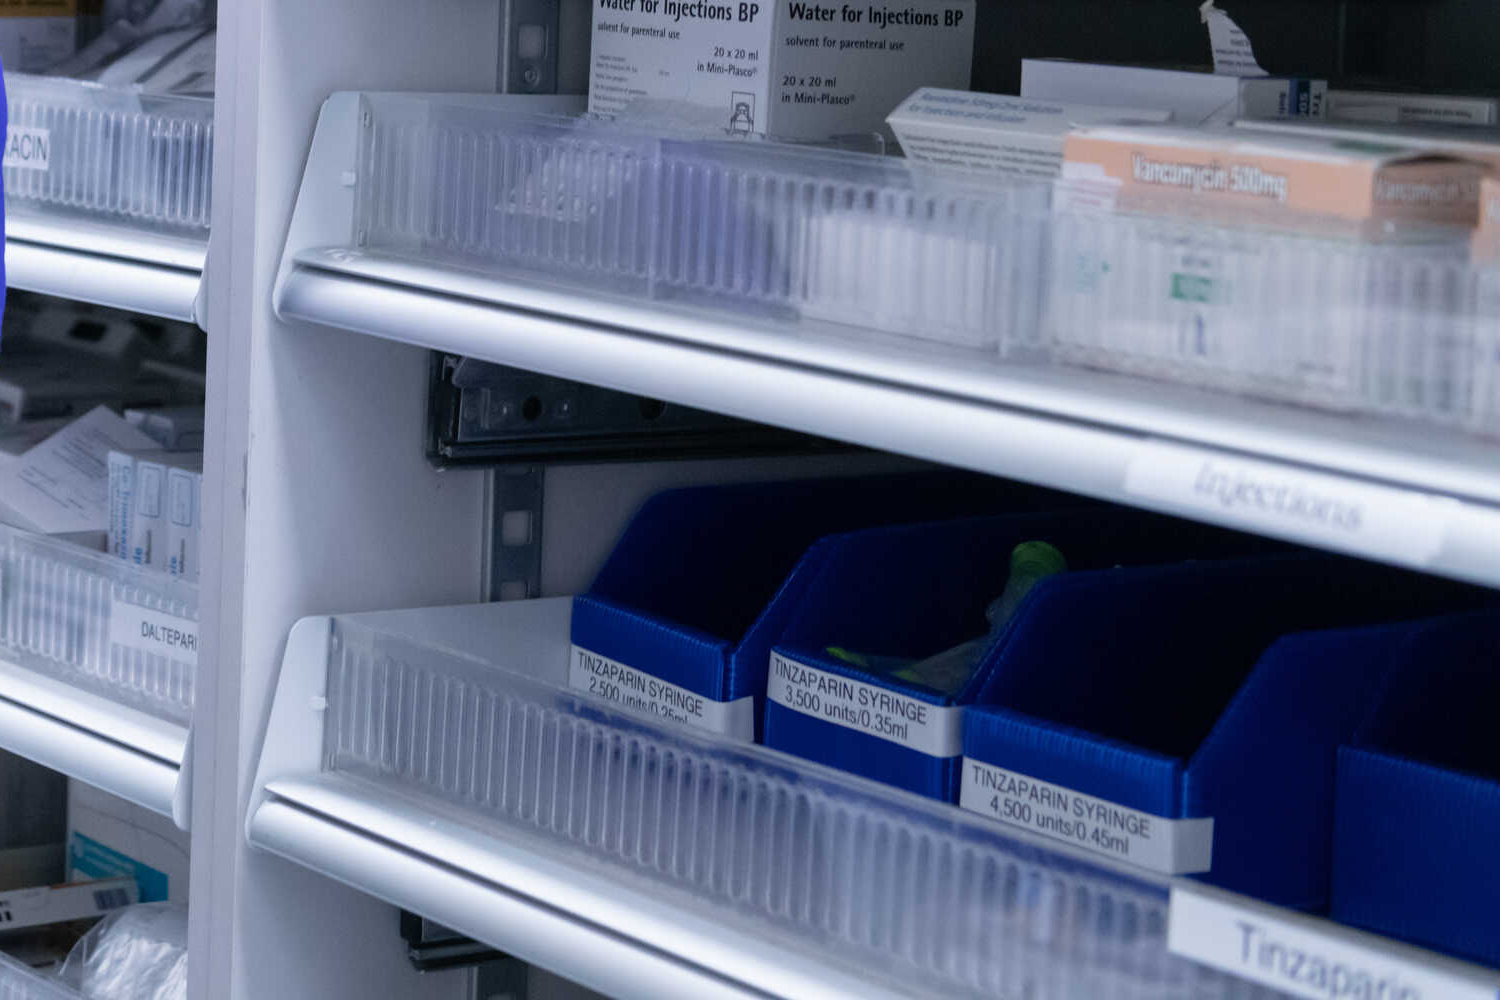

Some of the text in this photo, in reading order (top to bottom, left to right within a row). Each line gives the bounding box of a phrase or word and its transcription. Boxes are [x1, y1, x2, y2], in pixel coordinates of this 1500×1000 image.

[738, 2, 760, 23] BP
[789, 2, 965, 30] Water for Injections BP
[597, 21, 681, 41] solvent for parenteral use
[786, 35, 905, 51] solvent for parenteral use
[714, 46, 759, 61] 20 x 20 ml
[697, 61, 705, 73] in
[782, 76, 838, 89] 20 x 20 ml
[781, 91, 792, 104] in
[1132, 151, 1229, 194] Vancomycin
[578, 651, 704, 718] TINZAPARIN SYRINGE
[774, 657, 928, 726] TINZAPARIN SYRINGE
[785, 684, 909, 741] 3,500 units/0.35ml
[972, 764, 1152, 840] TINZAPARIN SYRINGE
[990, 794, 1131, 856] 4,500 units/0.45ml
